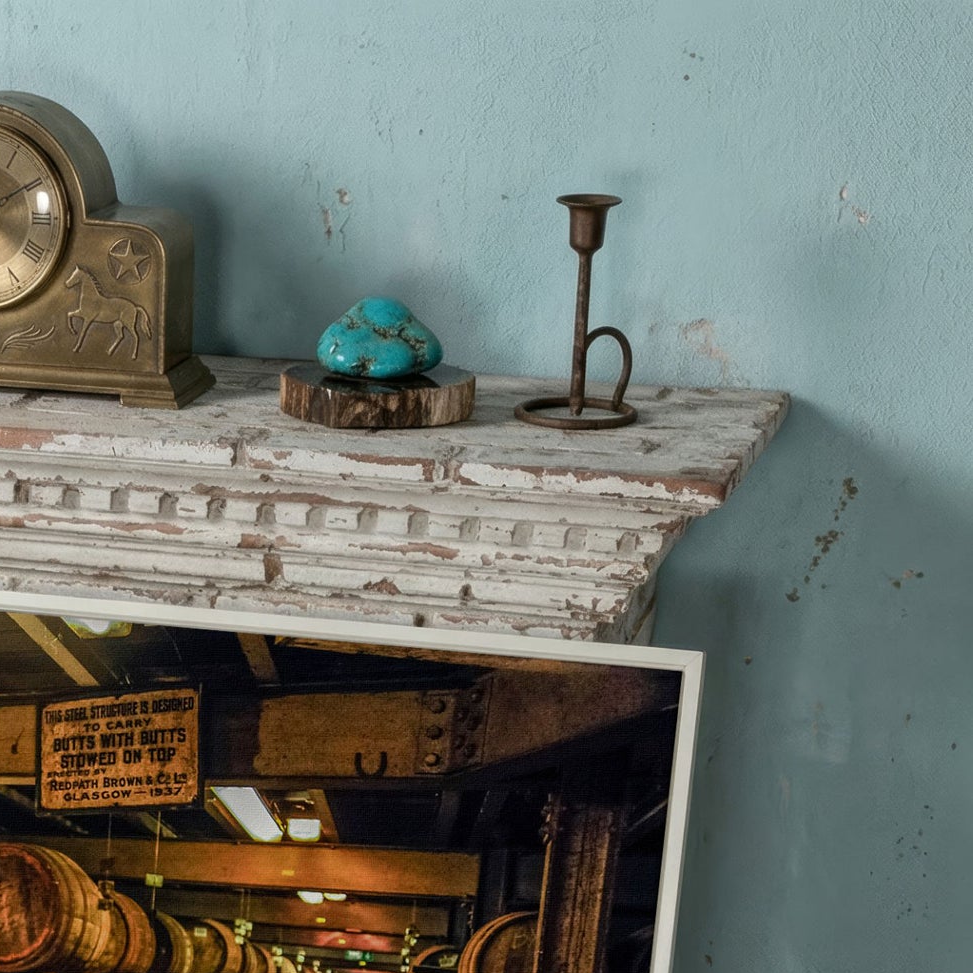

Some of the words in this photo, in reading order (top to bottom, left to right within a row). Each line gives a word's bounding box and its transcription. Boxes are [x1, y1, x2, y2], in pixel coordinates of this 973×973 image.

[32, 212, 51, 226] III
[23, 239, 45, 264] IIII
[45, 710, 62, 723] THIS
[64, 707, 88, 722] STEEL
[90, 702, 138, 719] STRUCTURE
[140, 701, 149, 714] IS
[152, 697, 194, 713] DESIGNED
[84, 722, 100, 732] TO
[107, 717, 152, 730] CARRY
[53, 735, 96, 752] BUTTS
[100, 733, 134, 747] WITH
[140, 728, 186, 745] BUTTS
[60, 751, 117, 769] STOWED
[123, 749, 142, 764] ON
[149, 747, 176, 762] TOP
[47, 769, 90, 778] ERECTED
[94, 768, 107, 776] BY
[50, 779, 98, 791] REDPATH
[103, 776, 142, 788] BROWN
[146, 776, 153, 784] &
[63, 789, 131, 801] GLASGOW
